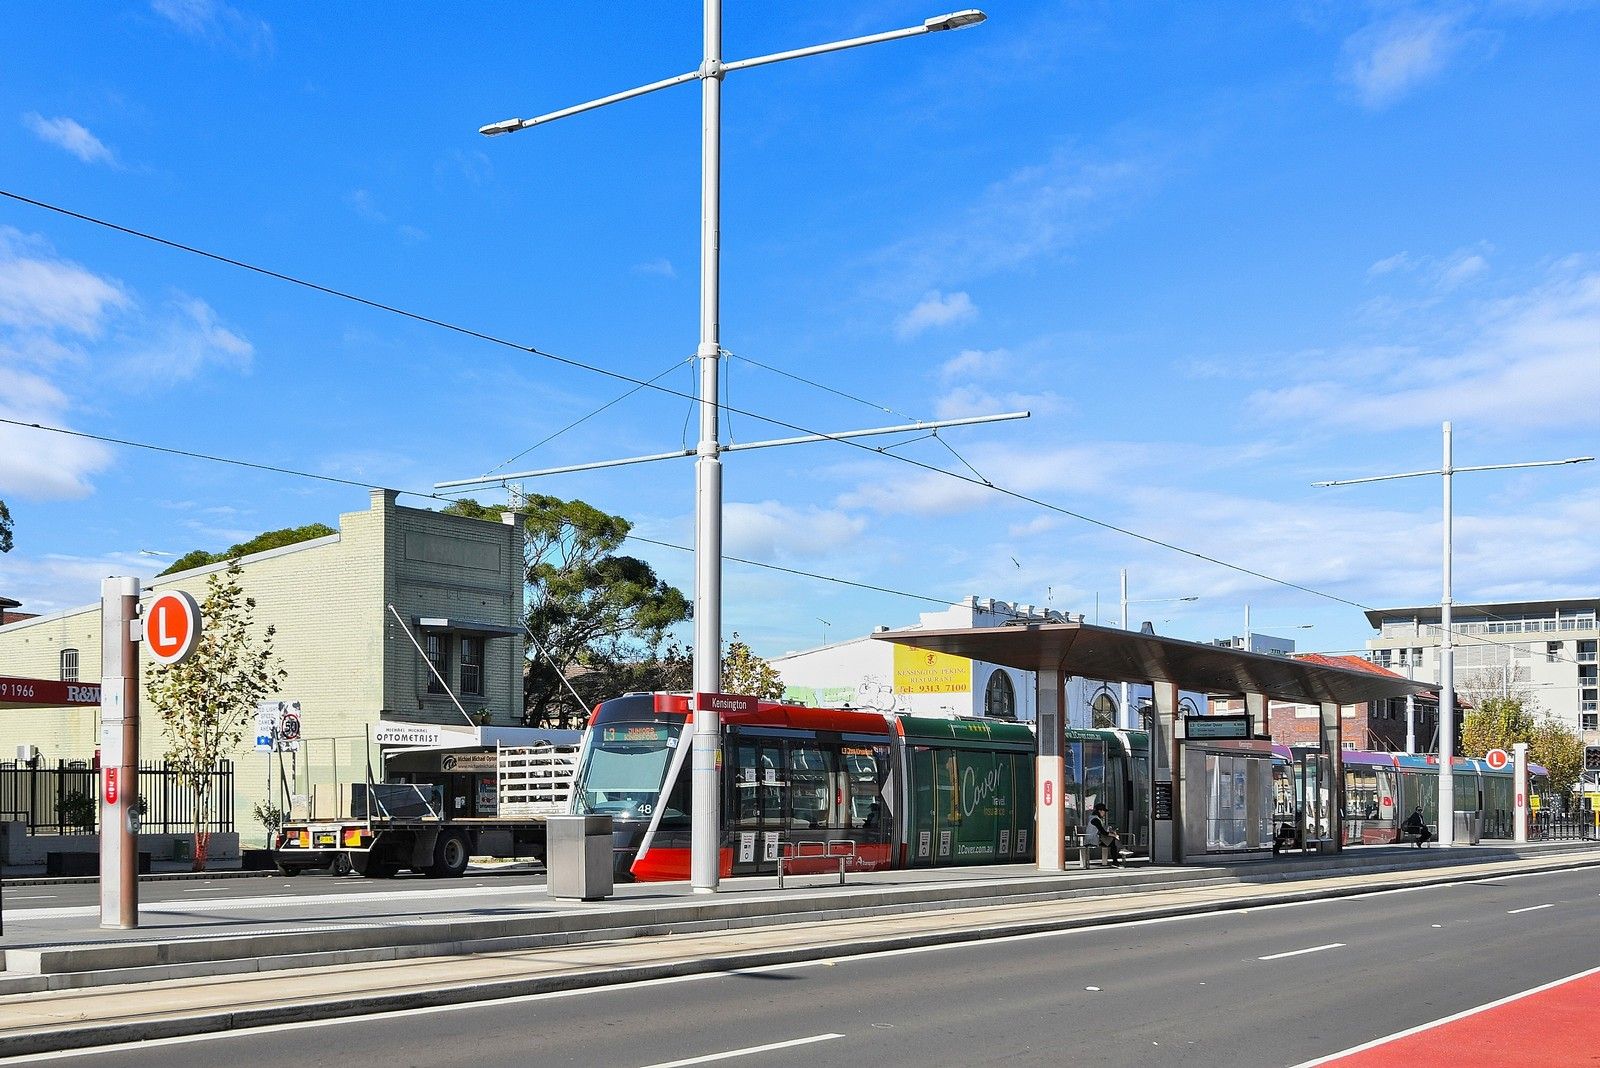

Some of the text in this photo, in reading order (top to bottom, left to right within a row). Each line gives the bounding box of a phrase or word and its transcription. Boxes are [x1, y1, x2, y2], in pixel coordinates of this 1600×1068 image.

[158, 606, 177, 647] L
[897, 667, 966, 676] KENSINGTON PEKING
[11, 684, 34, 697] 1966
[945, 683, 967, 692] 7100
[711, 697, 747, 711] Kensington
[376, 733, 439, 743] OPTOMETRIST
[603, 727, 615, 741] L3
[1493, 753, 1502, 765] L
[963, 763, 1003, 817] Cover
[637, 804, 652, 815] 48
[958, 844, 994, 855] 1Cover.com.au
